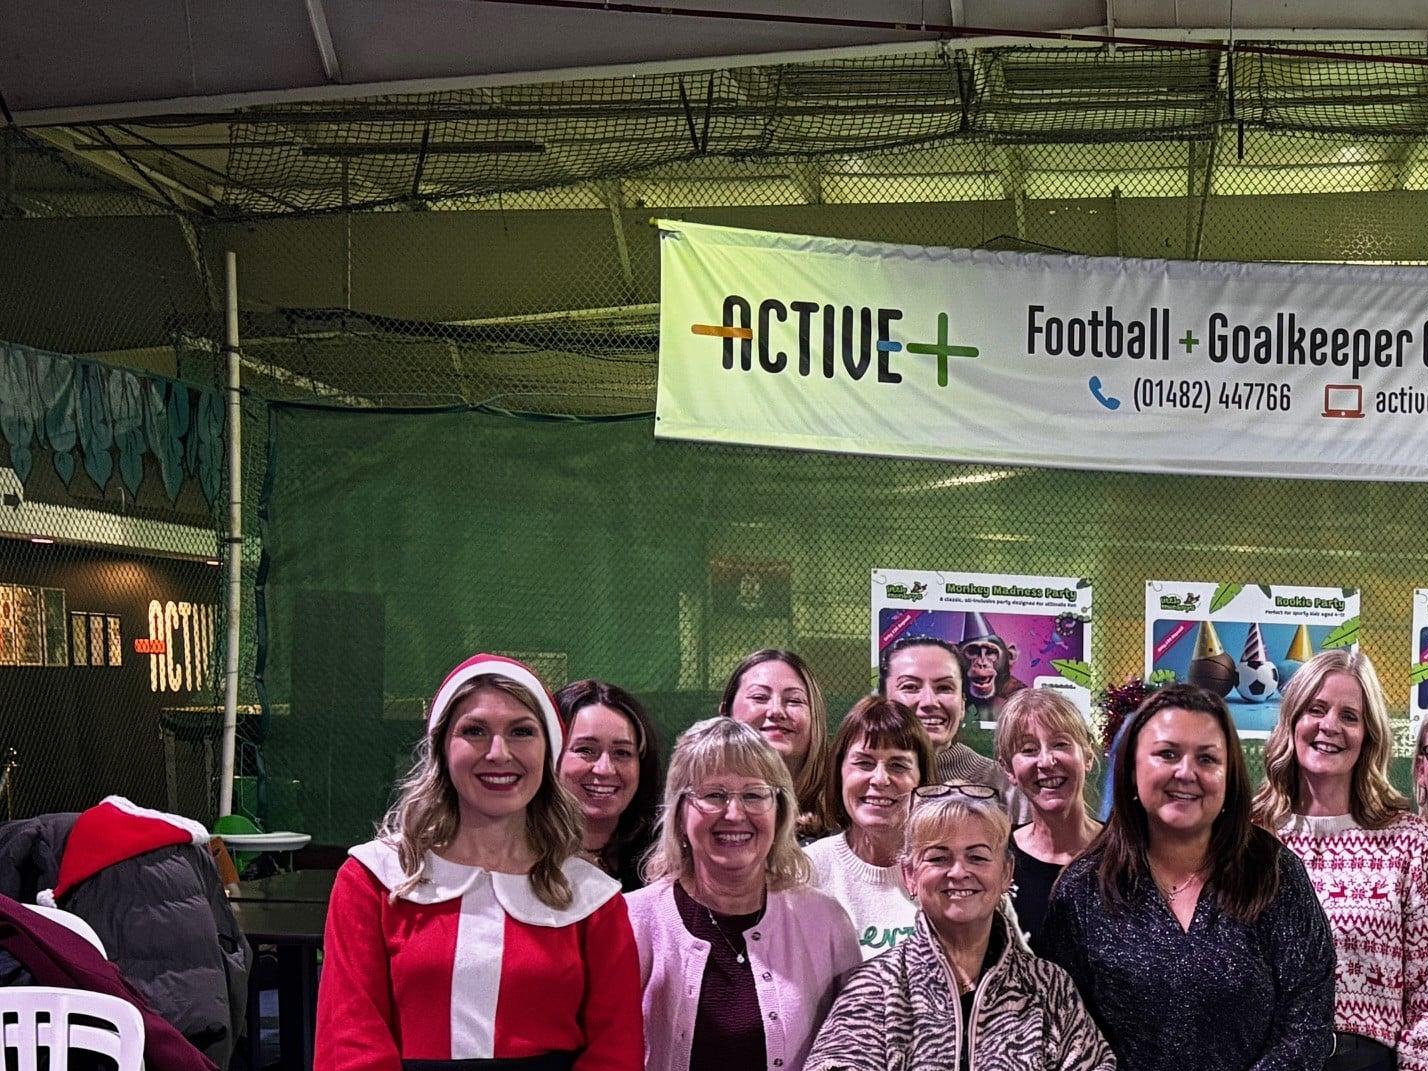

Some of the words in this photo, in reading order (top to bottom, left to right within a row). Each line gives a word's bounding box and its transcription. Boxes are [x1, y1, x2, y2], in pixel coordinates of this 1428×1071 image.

[1027, 304, 1170, 360] Football
[1208, 311, 1413, 380] Goalkeeper
[1133, 376, 1212, 414] (01482)
[1218, 381, 1291, 412] 447766
[945, 582, 990, 598] Monkey
[991, 585, 1043, 598] Madness
[1044, 587, 1077, 602] Party
[1275, 595, 1313, 608] Rookie
[1314, 597, 1346, 612] Party
